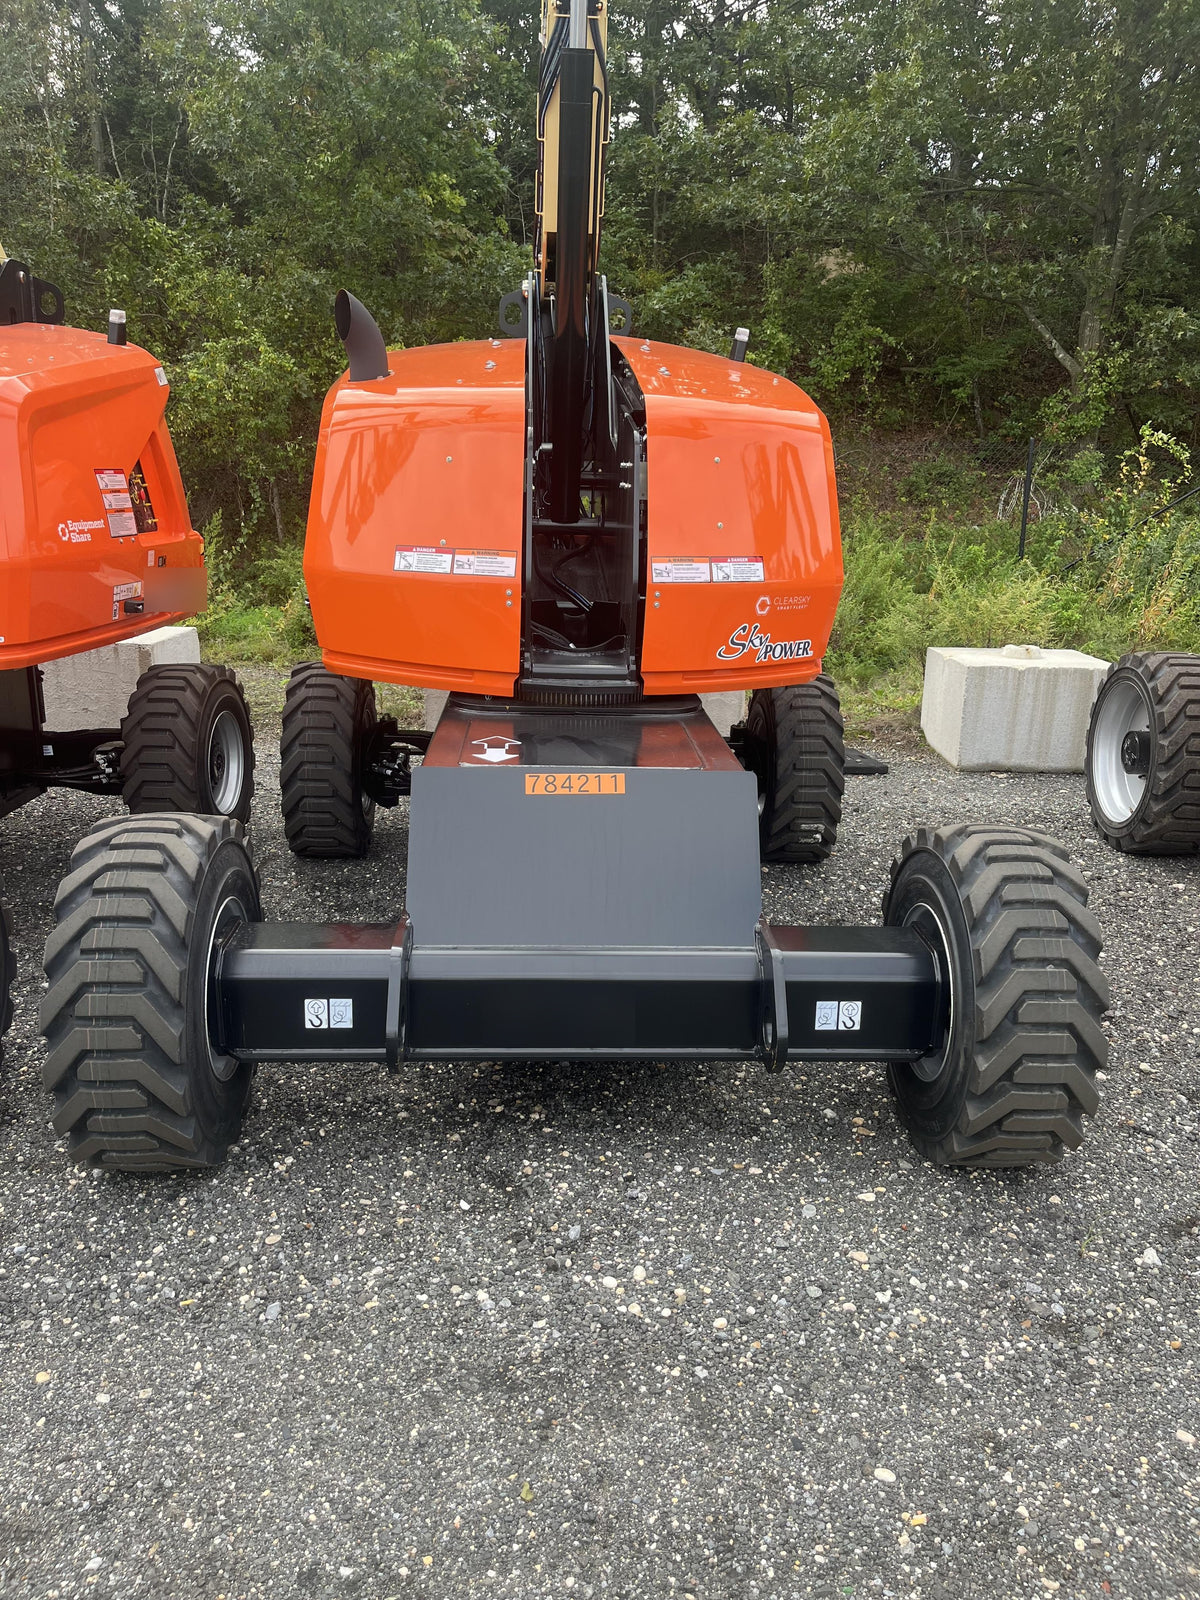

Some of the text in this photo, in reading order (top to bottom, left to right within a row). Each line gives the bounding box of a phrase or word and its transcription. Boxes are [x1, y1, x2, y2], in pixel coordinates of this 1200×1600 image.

[67, 519, 105, 533] Equipment
[70, 533, 92, 543] Share
[773, 596, 811, 606] CLEARSKY
[763, 639, 812, 661] POWER
[528, 774, 618, 793] 784211
